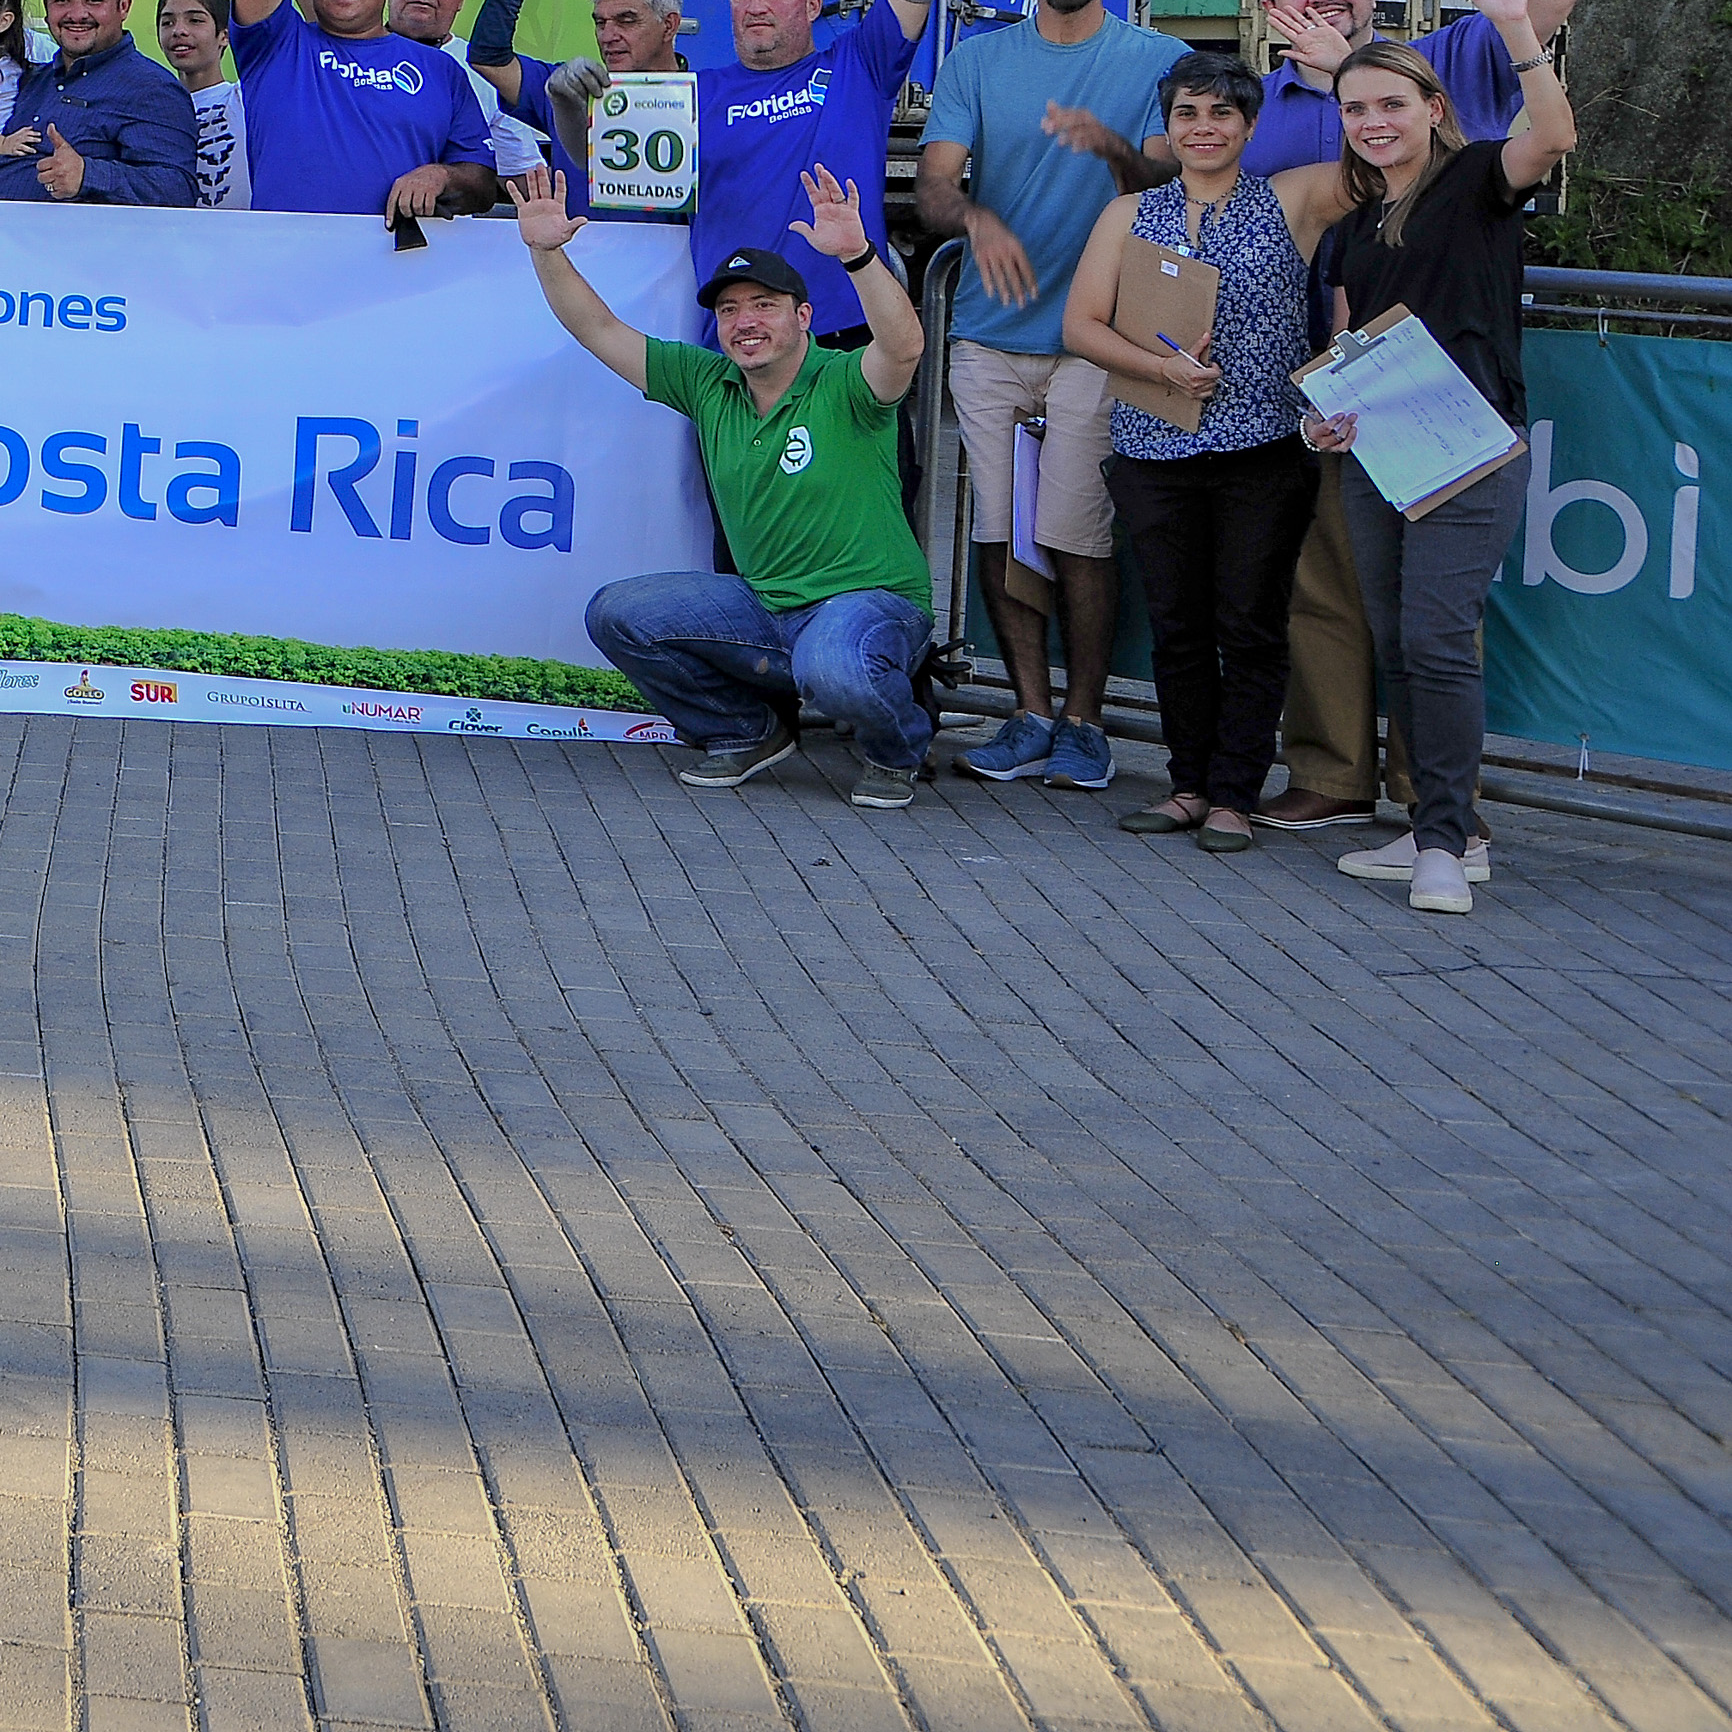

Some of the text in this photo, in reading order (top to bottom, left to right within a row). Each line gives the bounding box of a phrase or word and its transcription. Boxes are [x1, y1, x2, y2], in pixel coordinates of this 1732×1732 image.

[634, 98, 685, 110] ecolones
[727, 88, 810, 126] Florida
[599, 129, 684, 173] 30
[597, 181, 684, 199] TONELADAS
[290, 415, 575, 552] Rica
[64, 687, 103, 699] GOLLO
[130, 683, 176, 703] SUR
[351, 702, 421, 721] NUMAR
[448, 720, 503, 733] Clover
